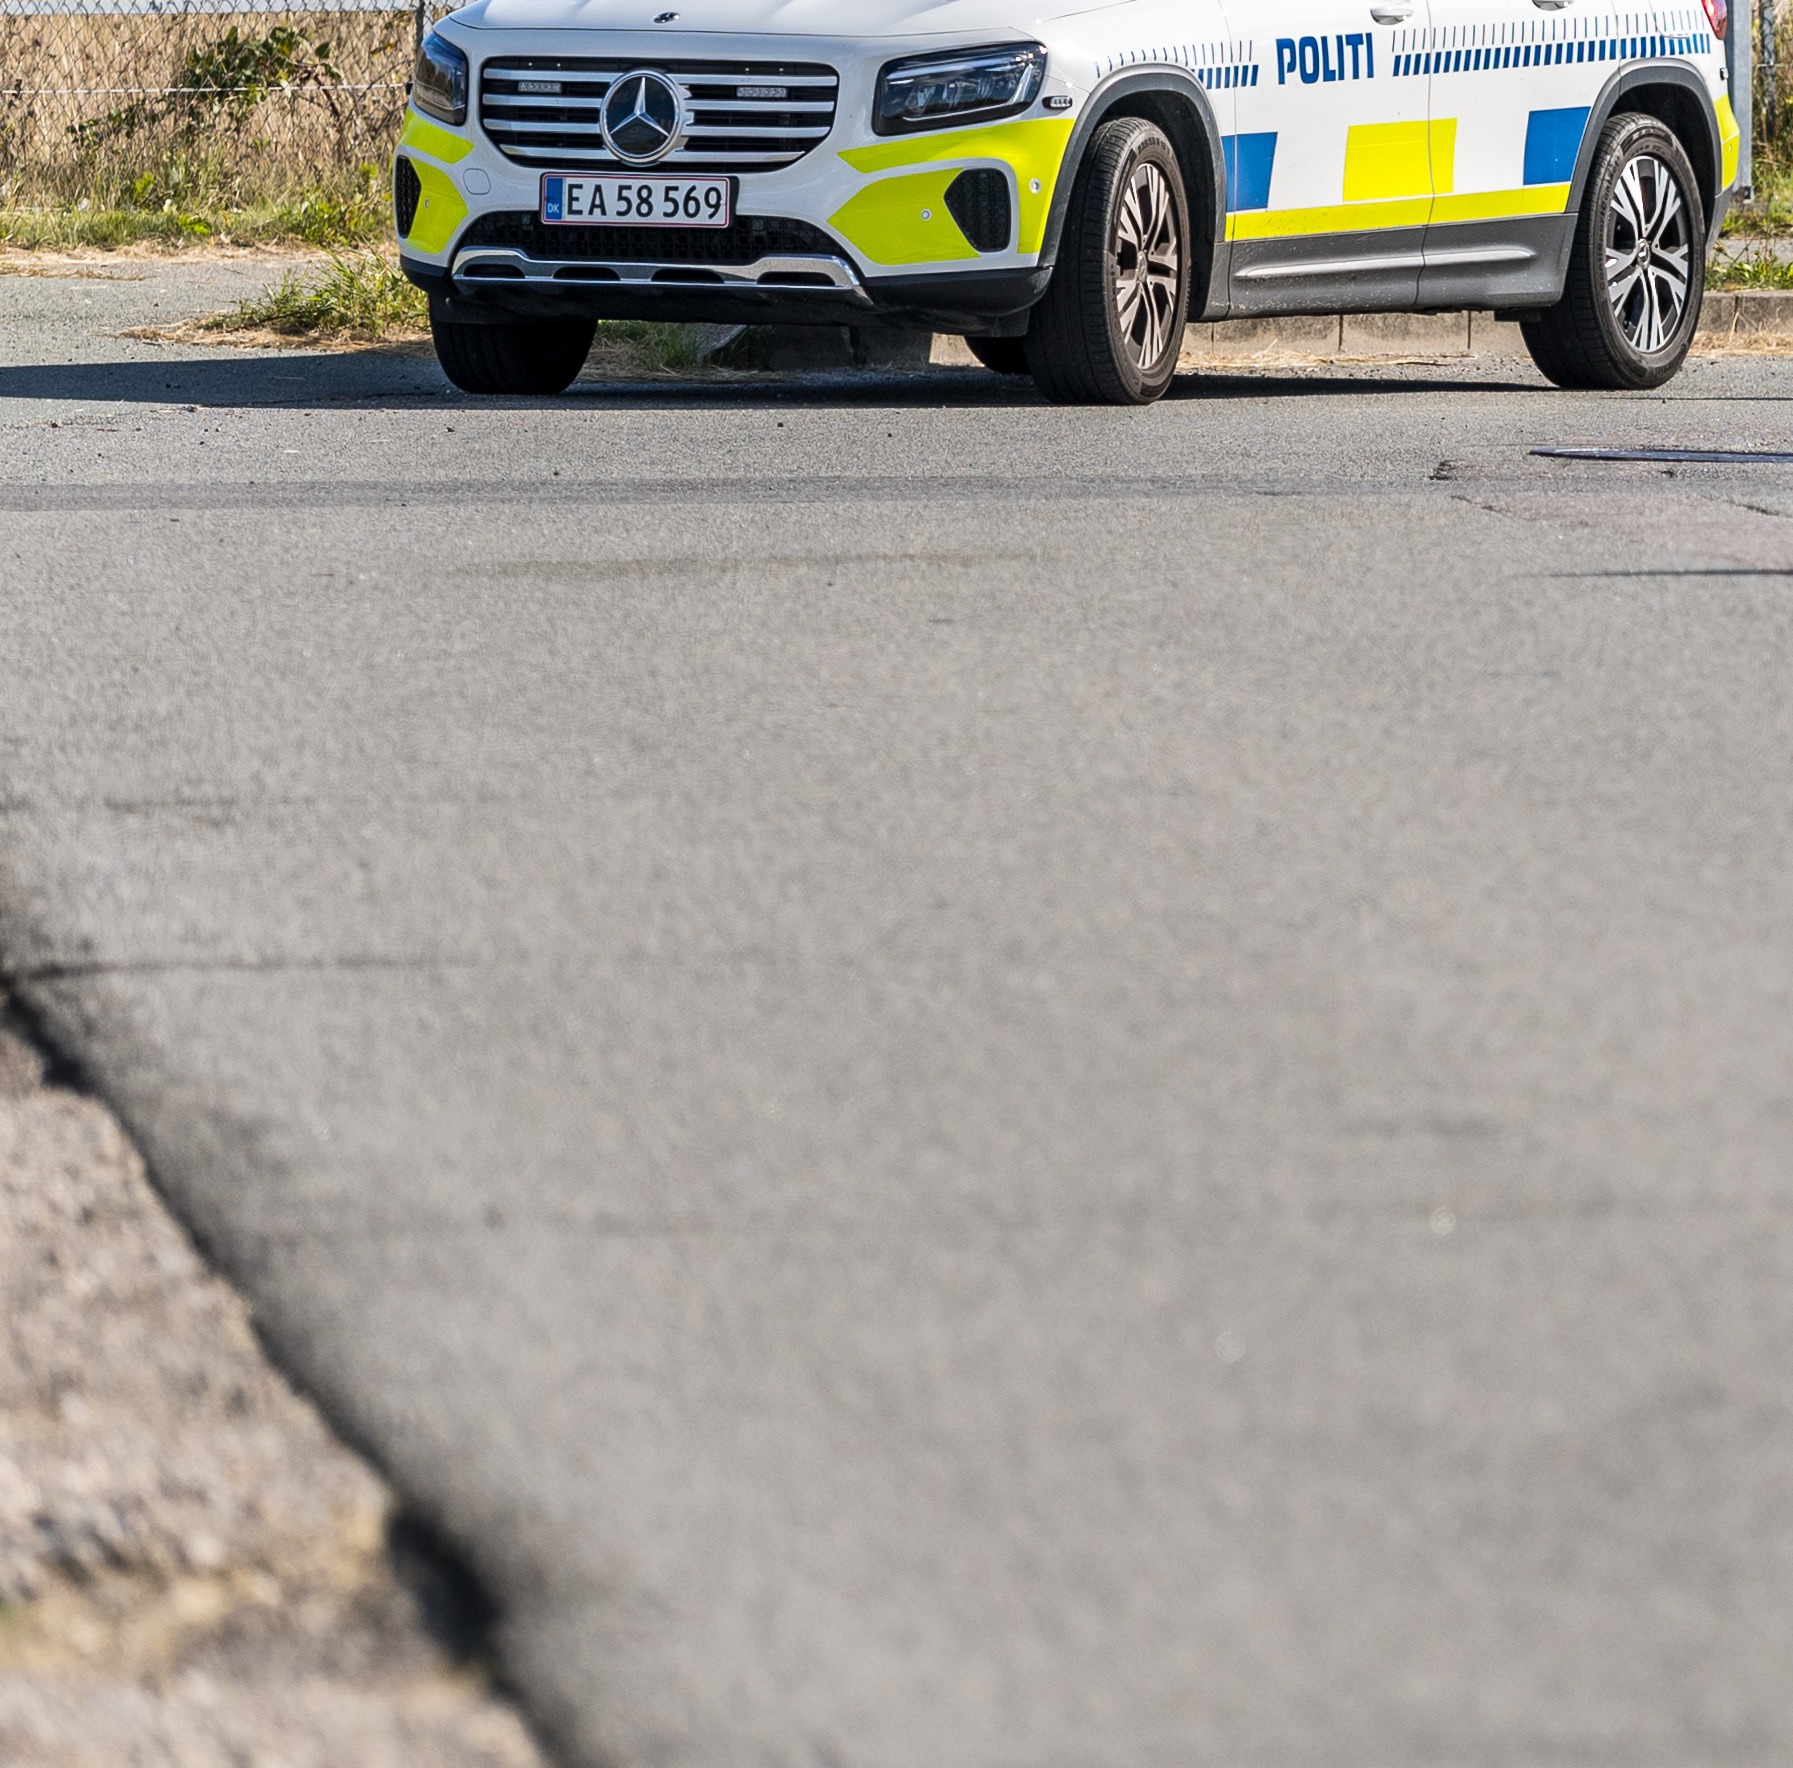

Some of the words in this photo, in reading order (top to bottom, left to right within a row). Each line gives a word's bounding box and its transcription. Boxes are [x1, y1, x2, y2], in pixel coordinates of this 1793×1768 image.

[1275, 32, 1374, 85] POLITI
[547, 202, 560, 214] DK
[567, 183, 607, 216] EA
[616, 184, 654, 218] 58
[662, 185, 722, 220] 569
